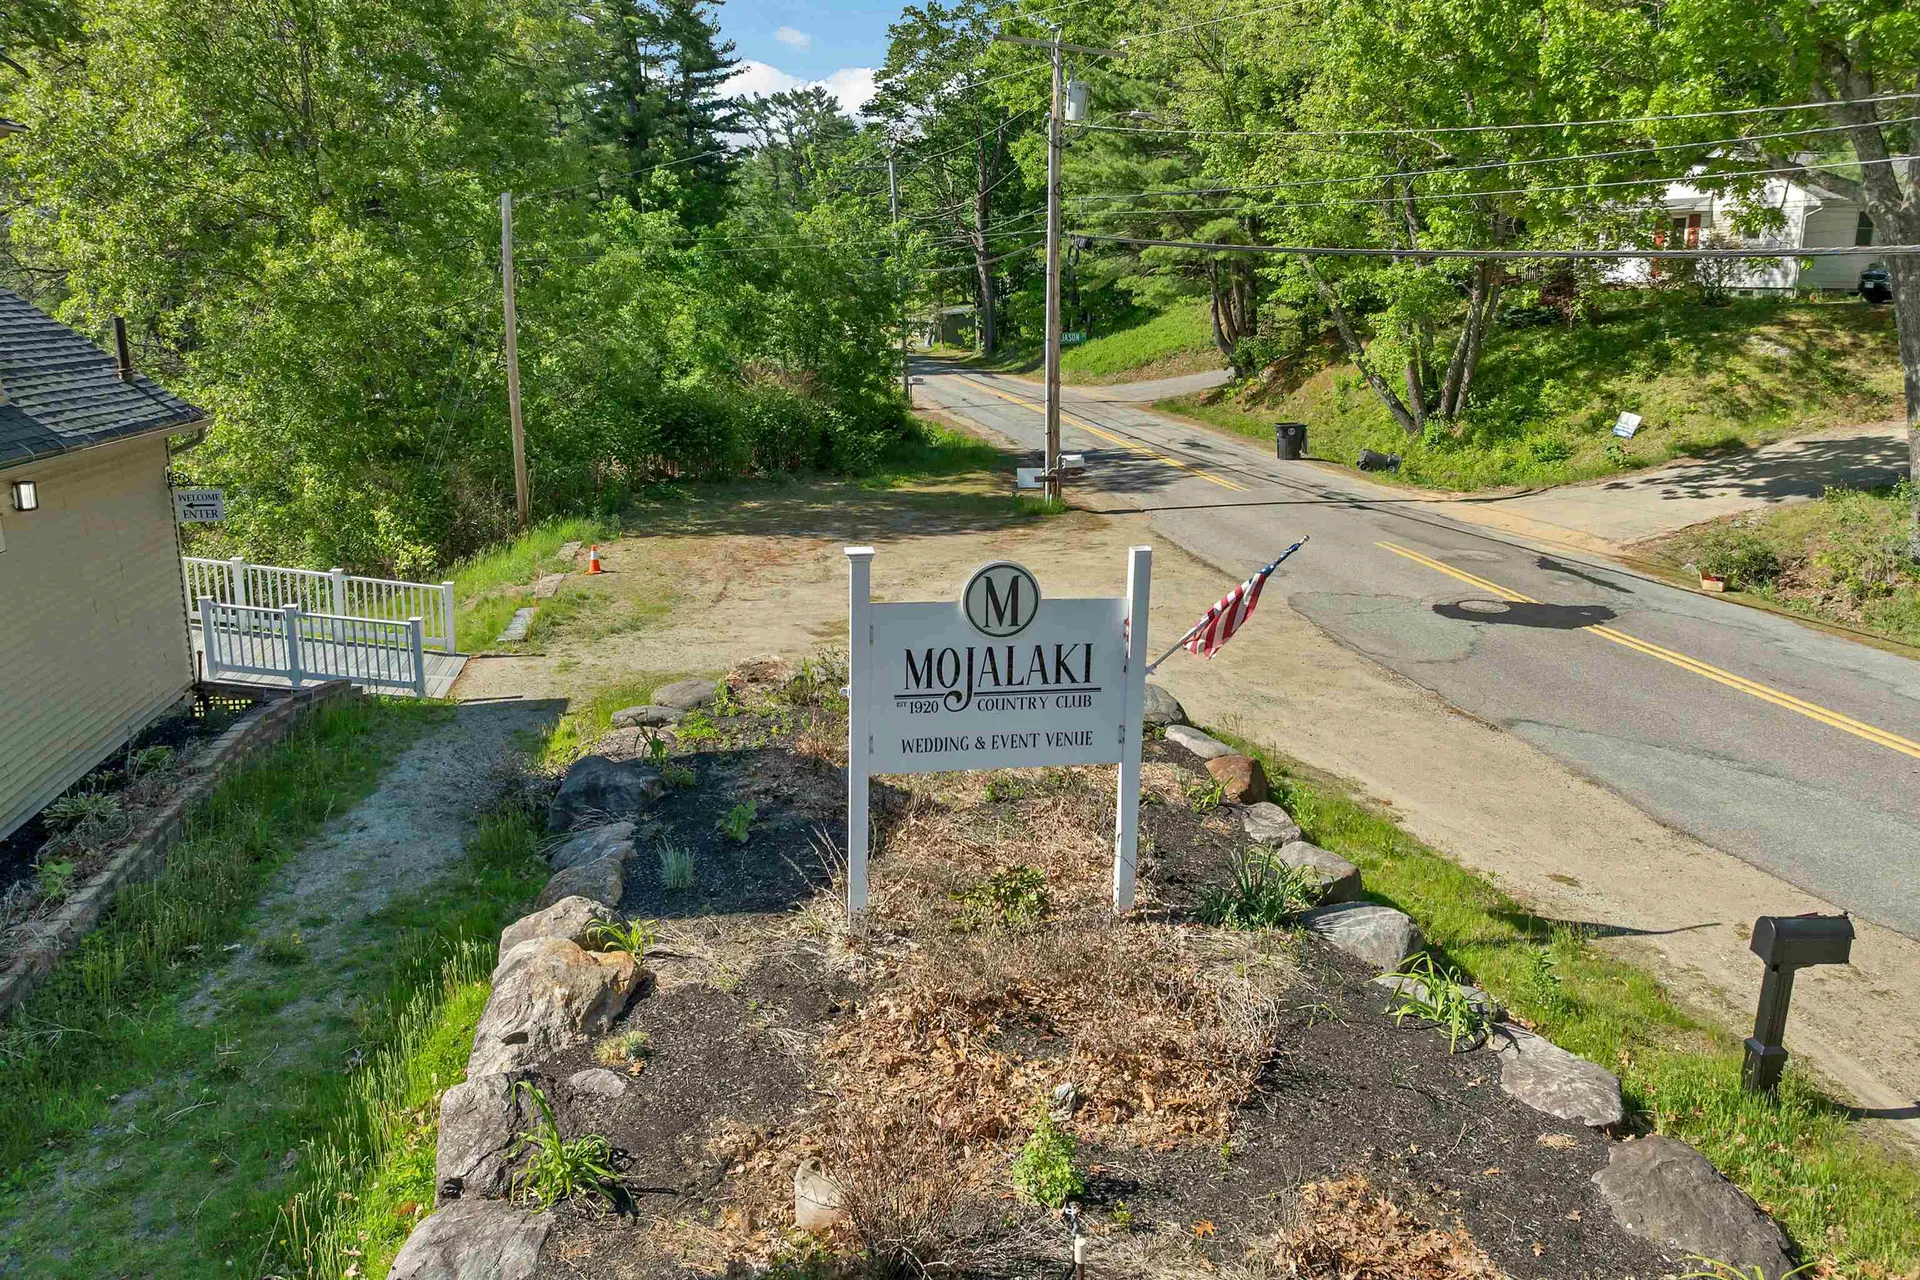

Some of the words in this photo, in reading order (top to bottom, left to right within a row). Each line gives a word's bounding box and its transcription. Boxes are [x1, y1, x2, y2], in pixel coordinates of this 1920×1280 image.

[178, 493, 220, 502] WELCOME
[183, 509, 219, 519] ENTER
[983, 575, 1022, 628] M
[903, 643, 1094, 712] MOJALAKI
[909, 700, 939, 714] 1920
[977, 696, 1048, 712] COUNTRY
[1055, 694, 1092, 709] CLUB
[901, 735, 969, 754] WEDDING
[974, 736, 986, 750] &
[991, 733, 1040, 750] EVENT
[1046, 730, 1093, 747] VENUE
